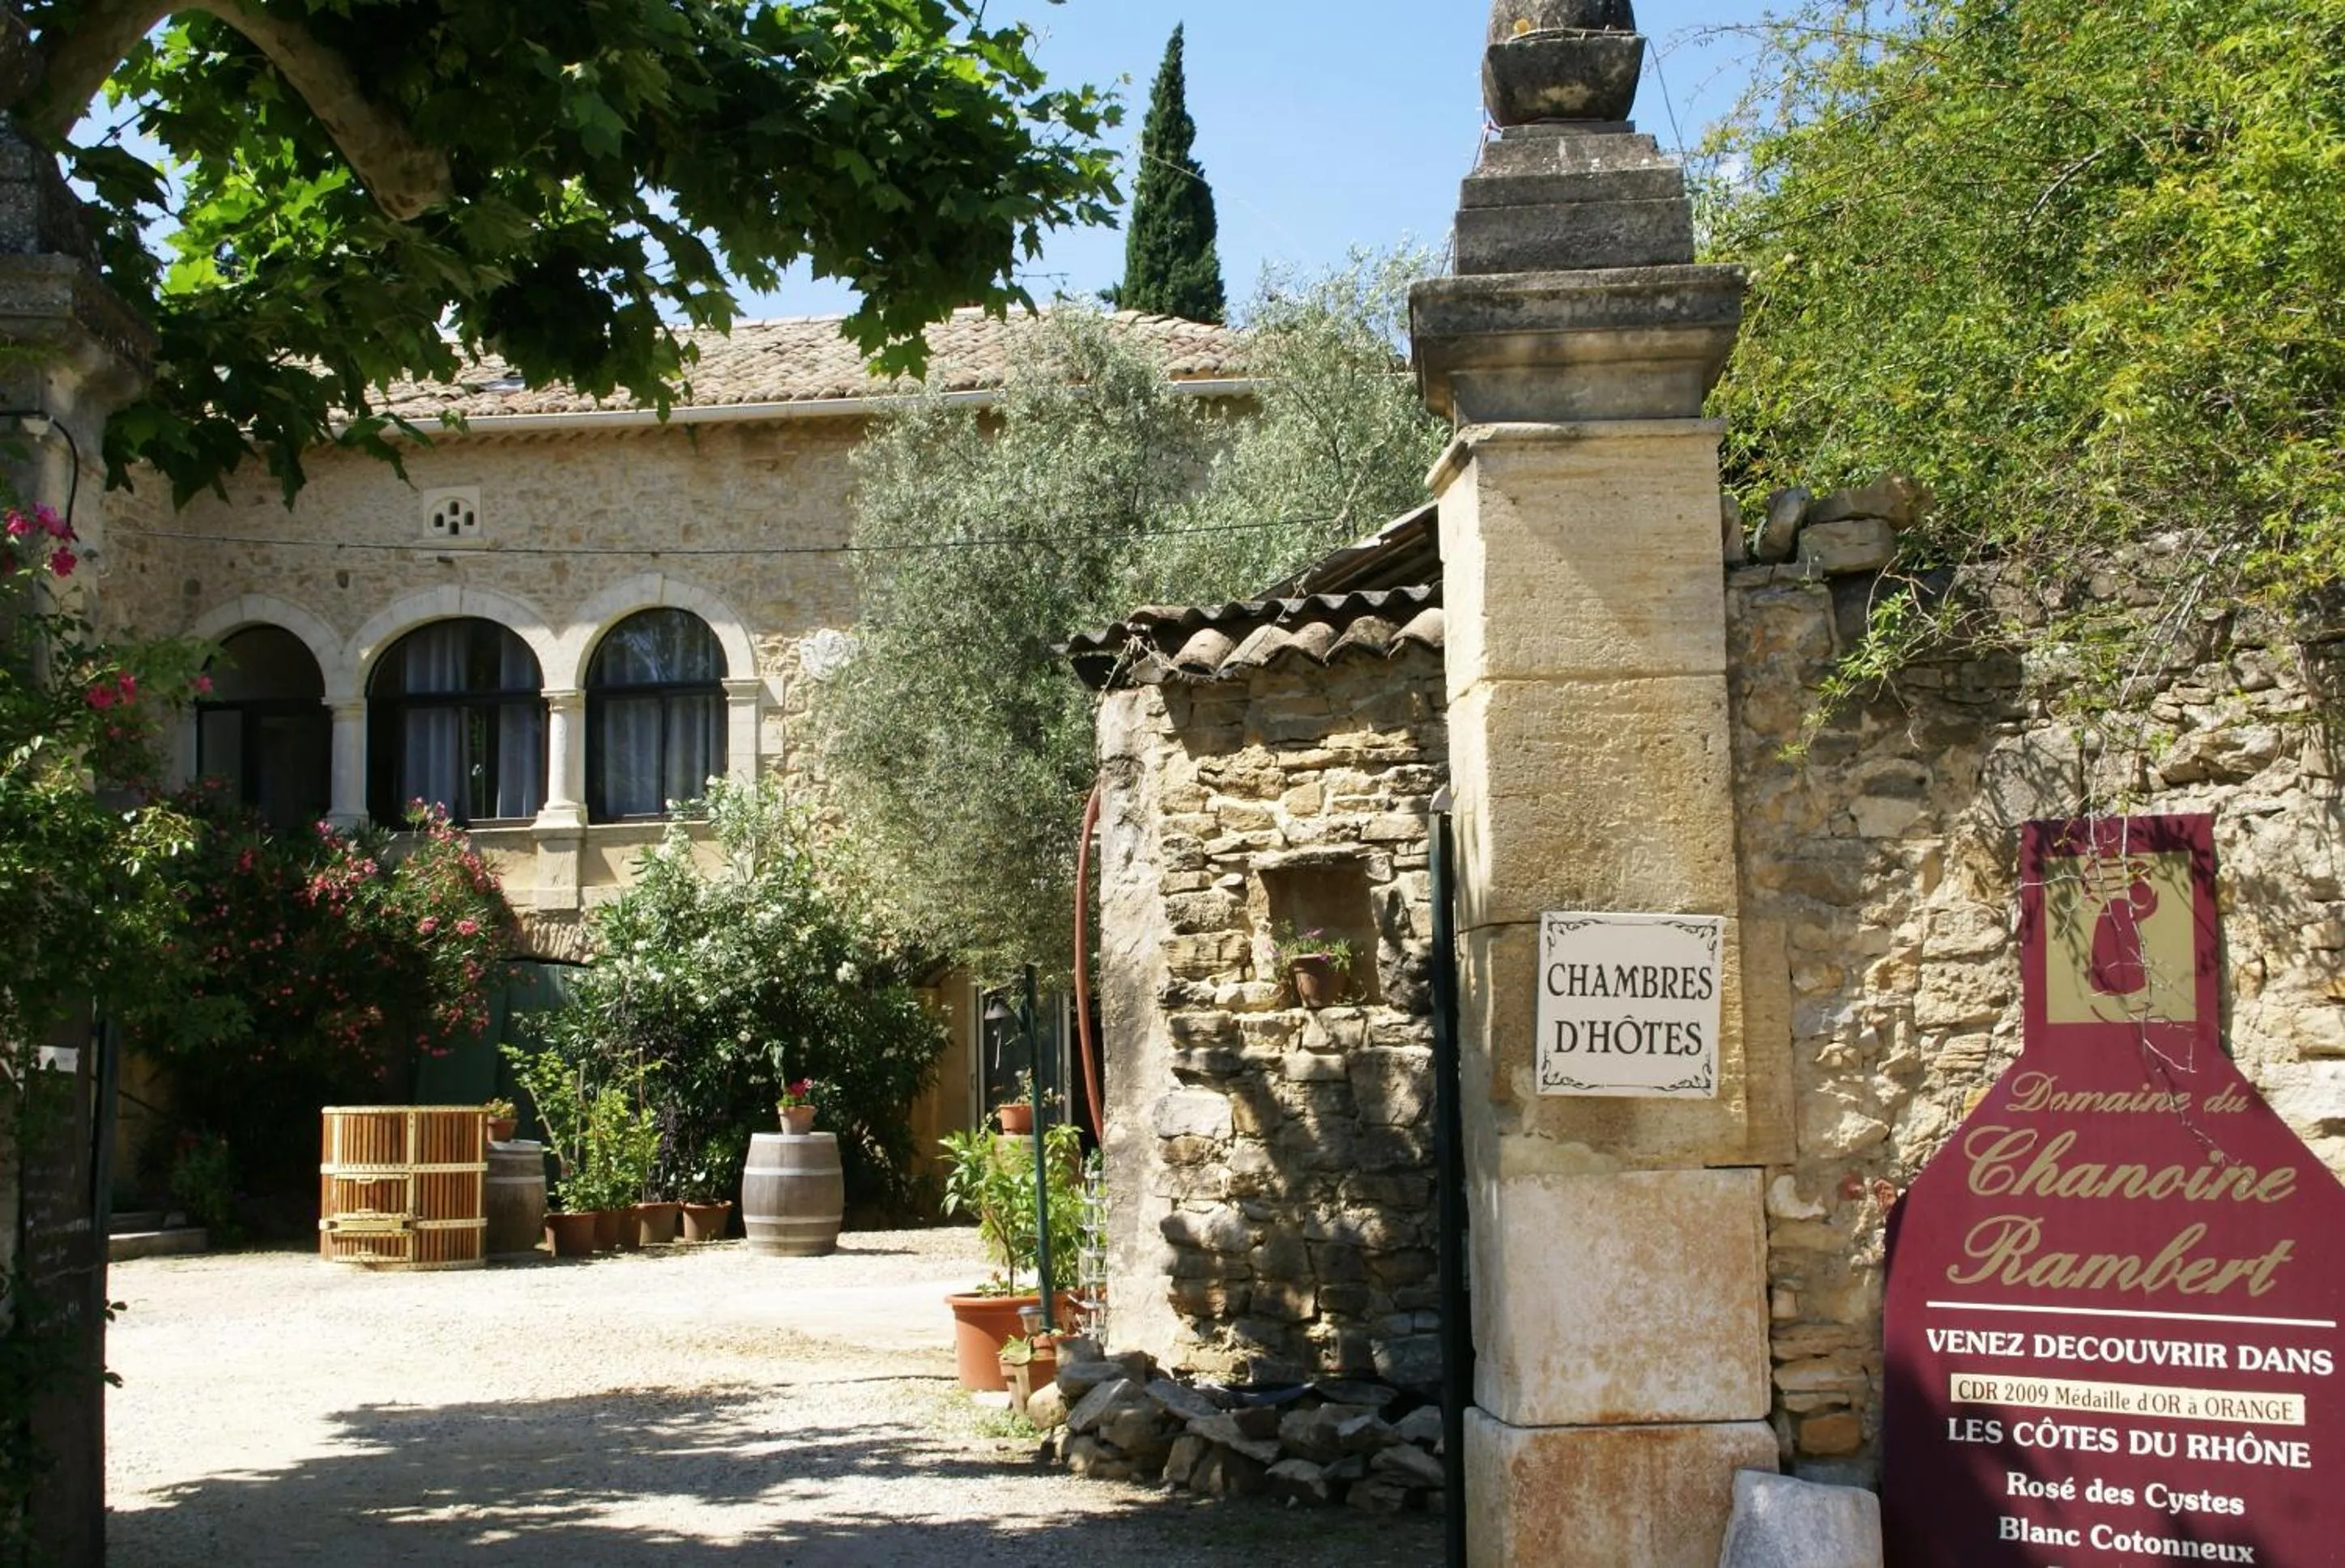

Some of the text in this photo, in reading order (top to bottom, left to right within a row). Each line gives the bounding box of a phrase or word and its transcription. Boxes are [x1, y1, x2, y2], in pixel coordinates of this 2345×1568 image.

[1547, 963, 1712, 1000] CHAMBRES
[1554, 1015, 1702, 1056] D'HÔTES
[2006, 1071, 2249, 1114] Domaine du
[1964, 1126, 2297, 1203] Chanoine
[1947, 1214, 2296, 1296] Rambert
[1926, 1328, 2334, 1375] VENEZ DECOUVRIR DANS
[1959, 1380, 2295, 1421] CDR 2009 Médaille d'OR à ORANGE
[1947, 1417, 2312, 1468] LES CÔTES DU RHÔNE
[2006, 1472, 2245, 1515] Rosé des Cystes
[1999, 1515, 2256, 1564] Blanc Cotonneux
